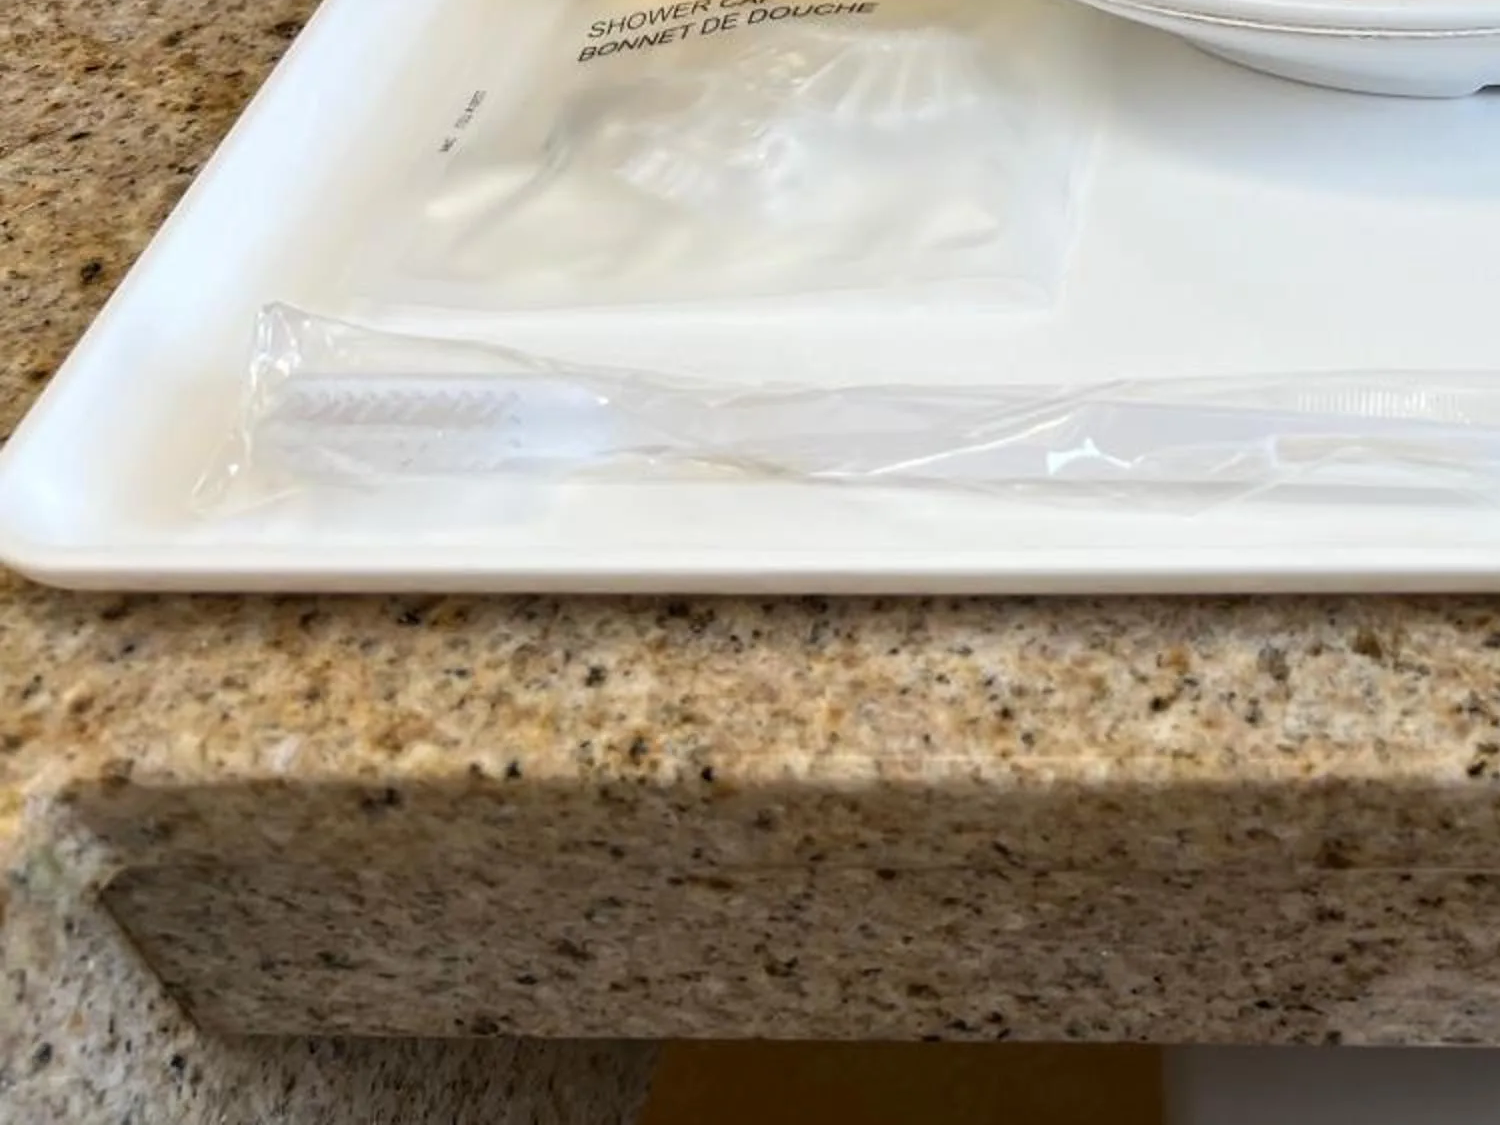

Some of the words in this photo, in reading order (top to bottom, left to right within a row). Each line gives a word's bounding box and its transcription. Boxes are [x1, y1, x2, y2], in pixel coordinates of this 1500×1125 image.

[576, 22, 694, 63] BONNET
[699, 12, 741, 36] DE
[746, 1, 881, 26] DOUCHE
